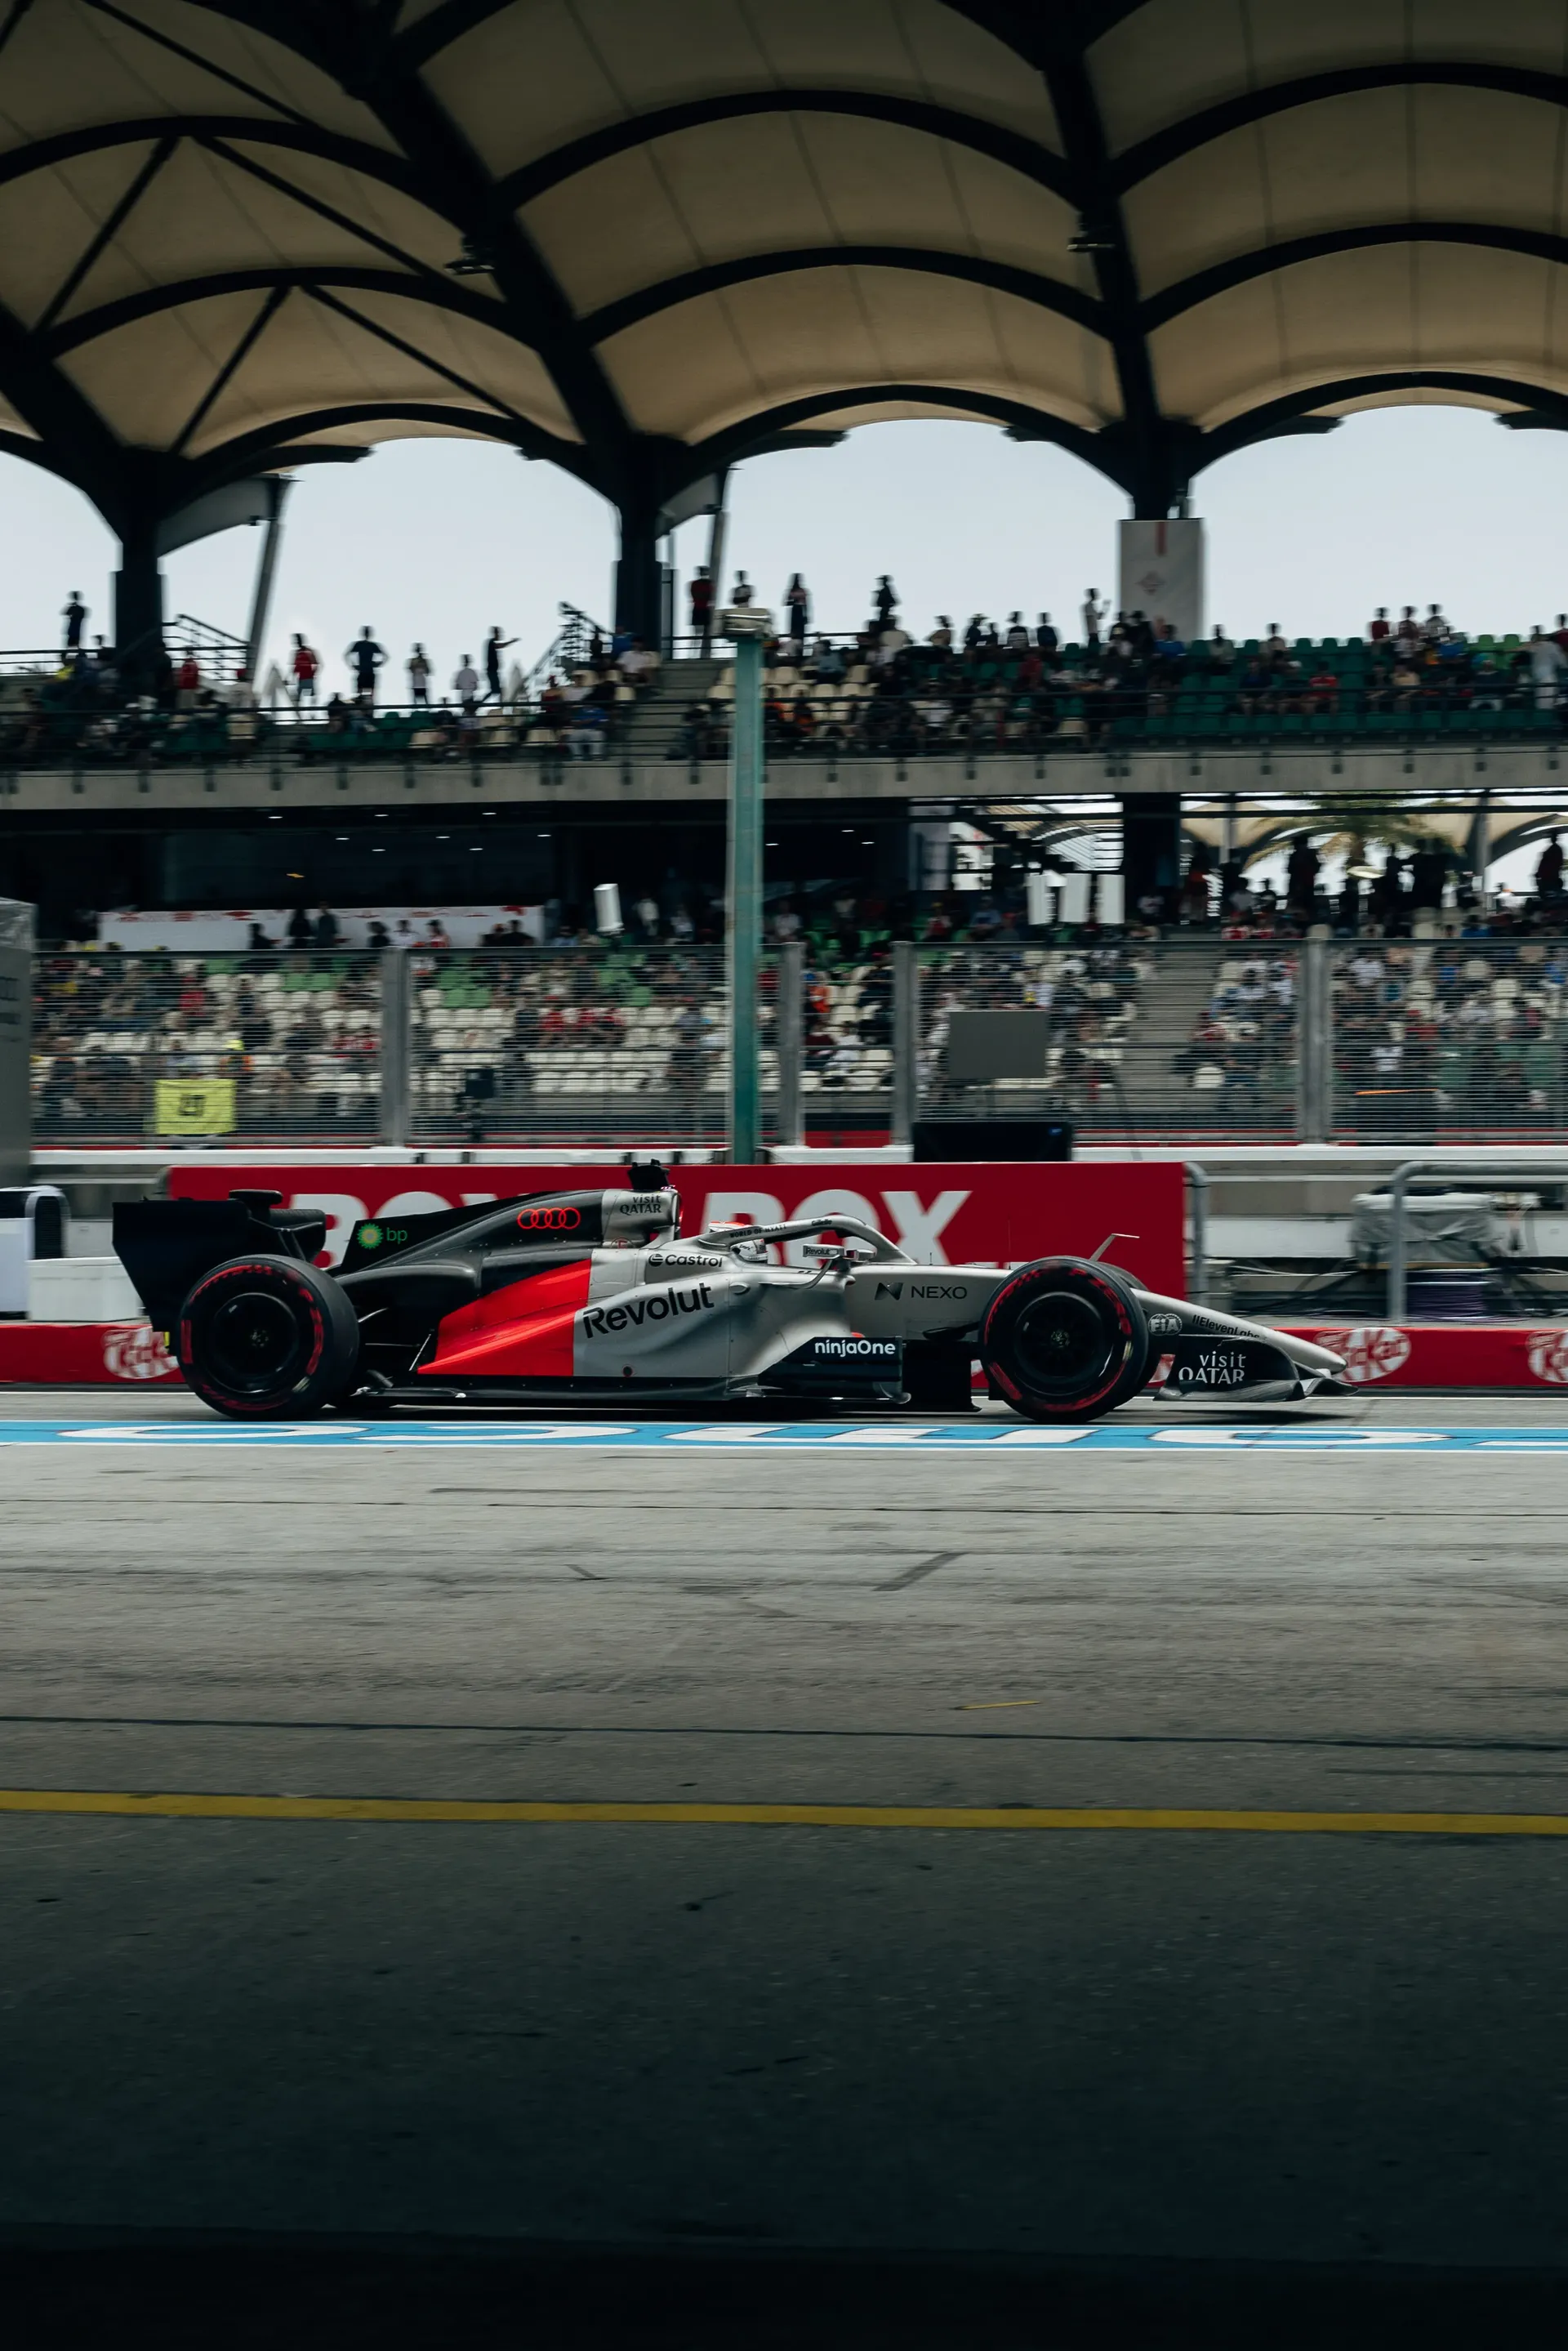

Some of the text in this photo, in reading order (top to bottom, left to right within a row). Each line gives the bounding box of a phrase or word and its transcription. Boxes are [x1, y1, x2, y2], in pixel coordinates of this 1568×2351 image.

[633, 1194, 661, 1203] visit
[620, 1203, 662, 1216] QATAR
[386, 1227, 408, 1245] bp
[805, 1247, 830, 1256] Revolut
[665, 1253, 722, 1267] Castrol
[911, 1286, 968, 1299] NEXO
[583, 1283, 715, 1339] Revolut
[815, 1340, 896, 1358] ninjaOne
[1200, 1350, 1246, 1368] visit
